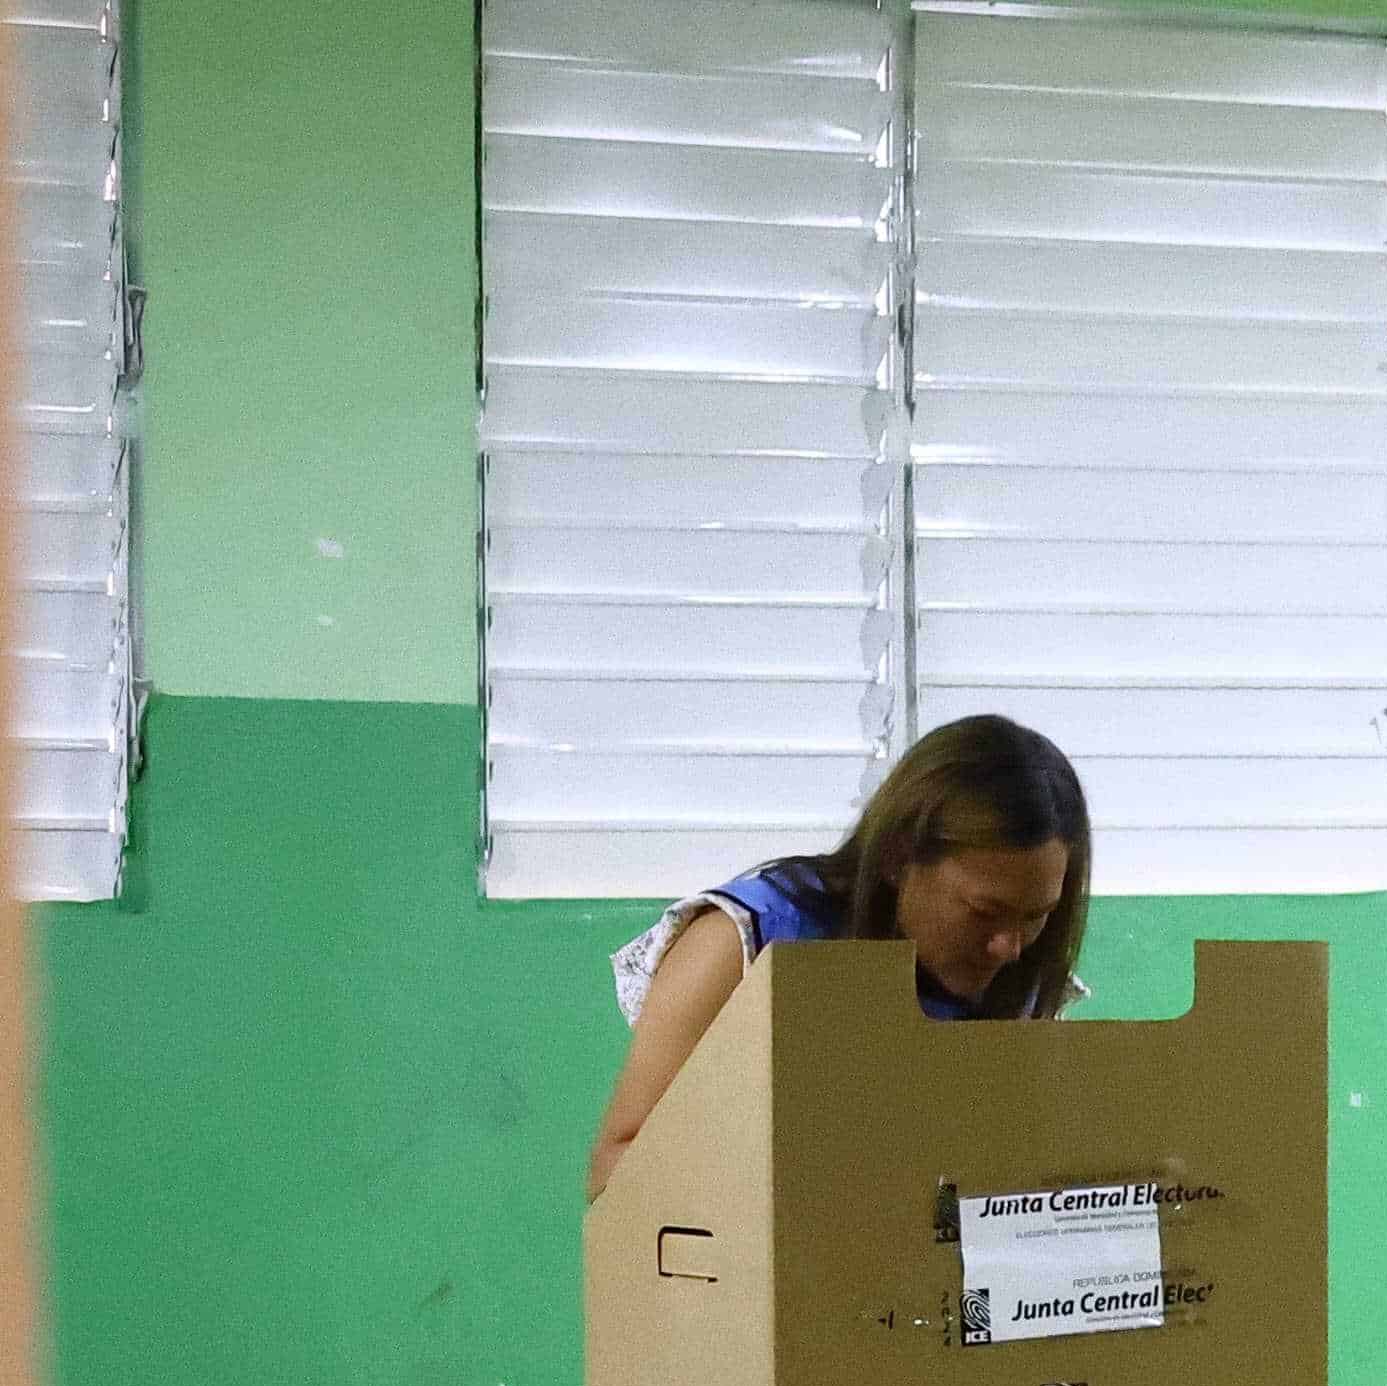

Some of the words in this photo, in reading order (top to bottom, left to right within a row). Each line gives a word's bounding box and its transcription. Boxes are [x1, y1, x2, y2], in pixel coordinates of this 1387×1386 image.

[979, 1196, 1043, 1219] Junta
[1049, 1184, 1128, 1213] Central
[1011, 1297, 1075, 1322] Junta
[1080, 1285, 1159, 1316] Central
